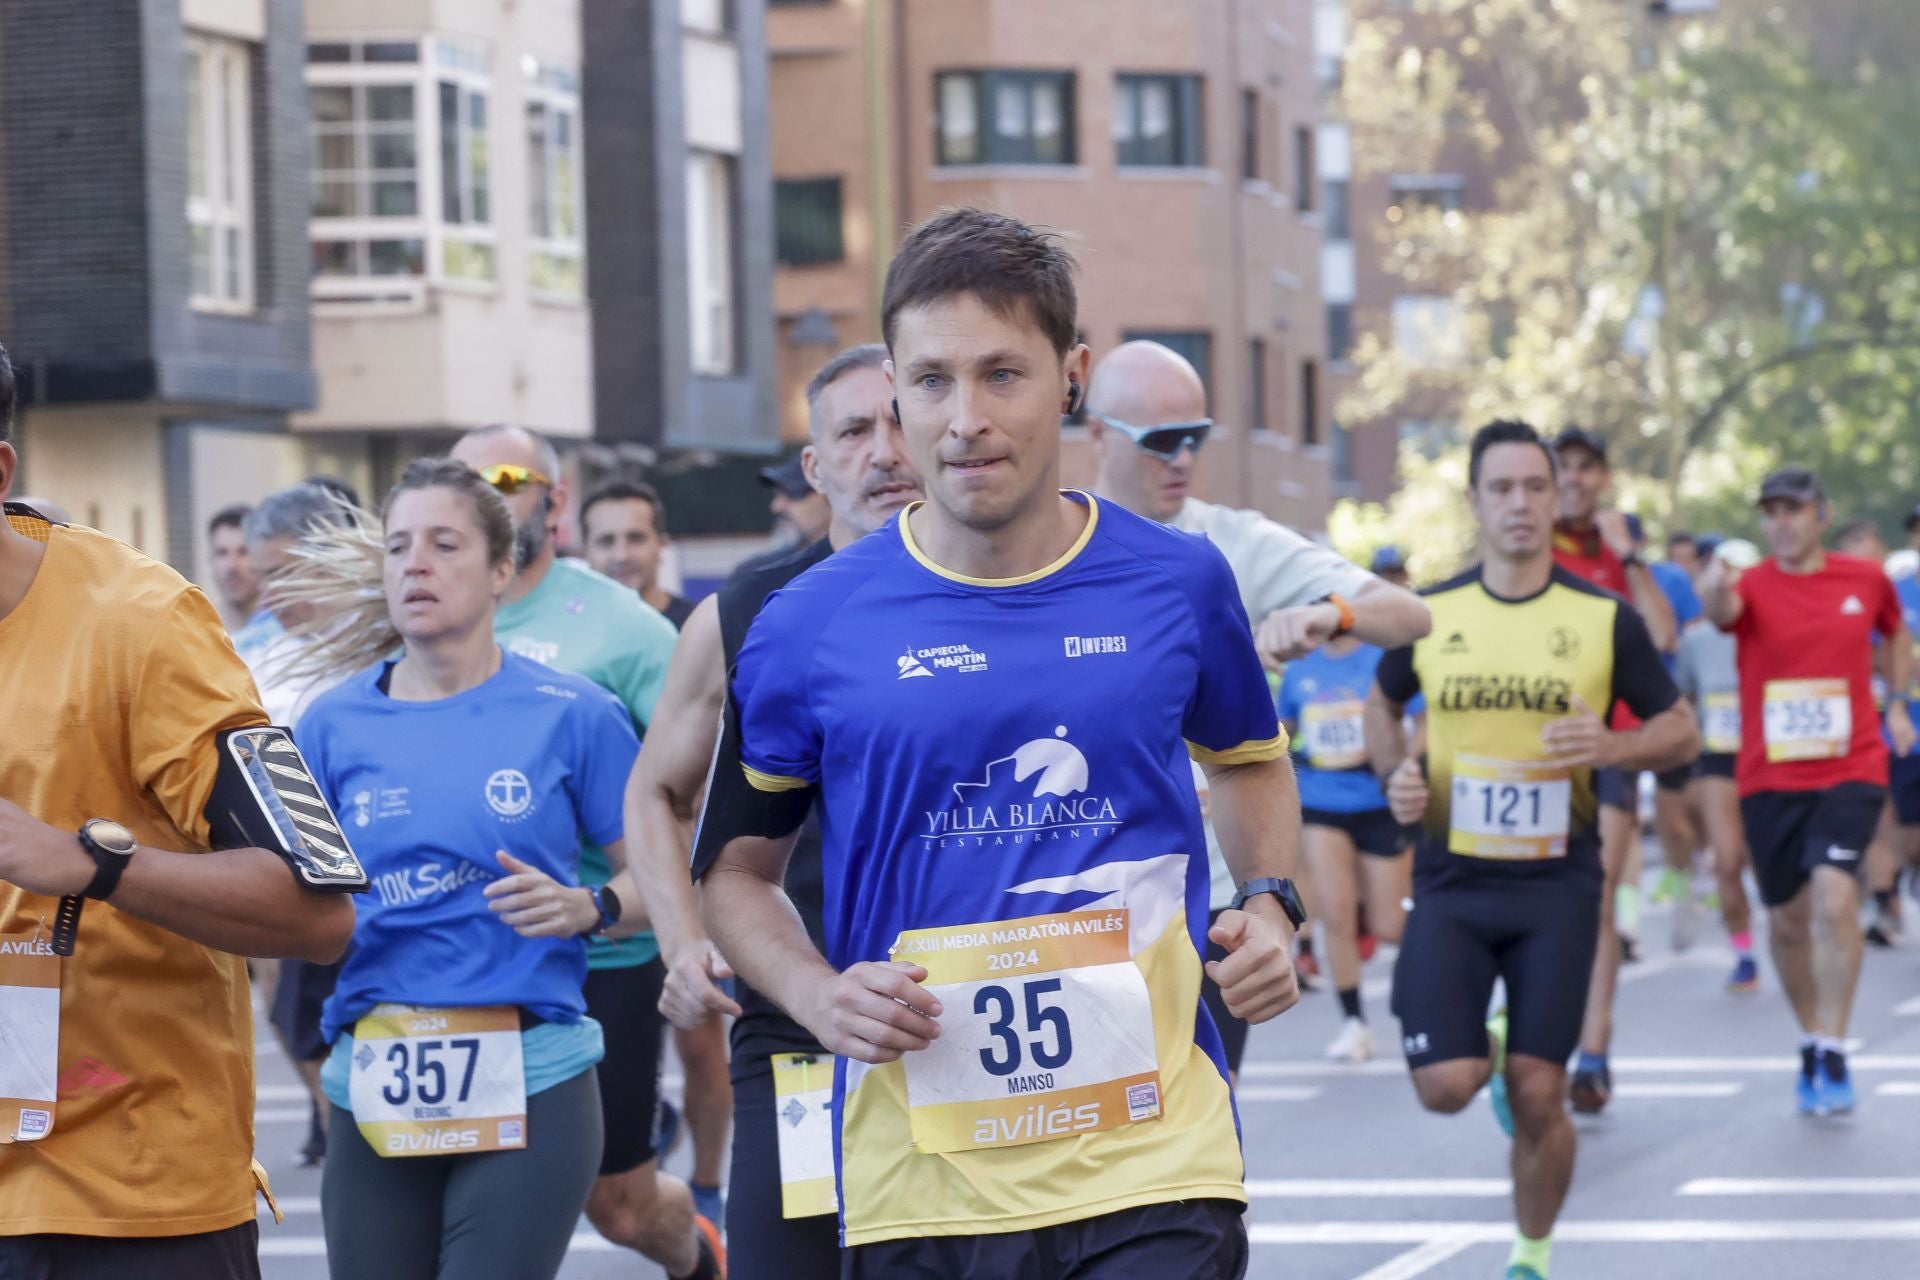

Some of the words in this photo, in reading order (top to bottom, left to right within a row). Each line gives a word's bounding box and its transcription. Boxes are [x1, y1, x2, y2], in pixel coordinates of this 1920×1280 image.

[917, 644, 970, 658] CAPIECHA
[934, 651, 987, 668] MARTÍN
[925, 806, 1000, 833] VILLA
[1008, 797, 1119, 828] BLANCA
[1479, 785, 1541, 826] 121
[925, 827, 1117, 850] RESTAURANTE
[372, 868, 418, 906] 10K
[0, 938, 55, 956] AVILÉS
[943, 931, 989, 951] MEDIA
[992, 919, 1070, 945] MARATÓN
[1072, 914, 1124, 935] AVILÉS
[986, 949, 1040, 971] 2024
[411, 1017, 449, 1031] 2024
[973, 977, 1073, 1077] 35
[383, 1038, 480, 1106] 357
[1007, 1073, 1054, 1094] MANSO
[973, 1101, 1101, 1143] avilés
